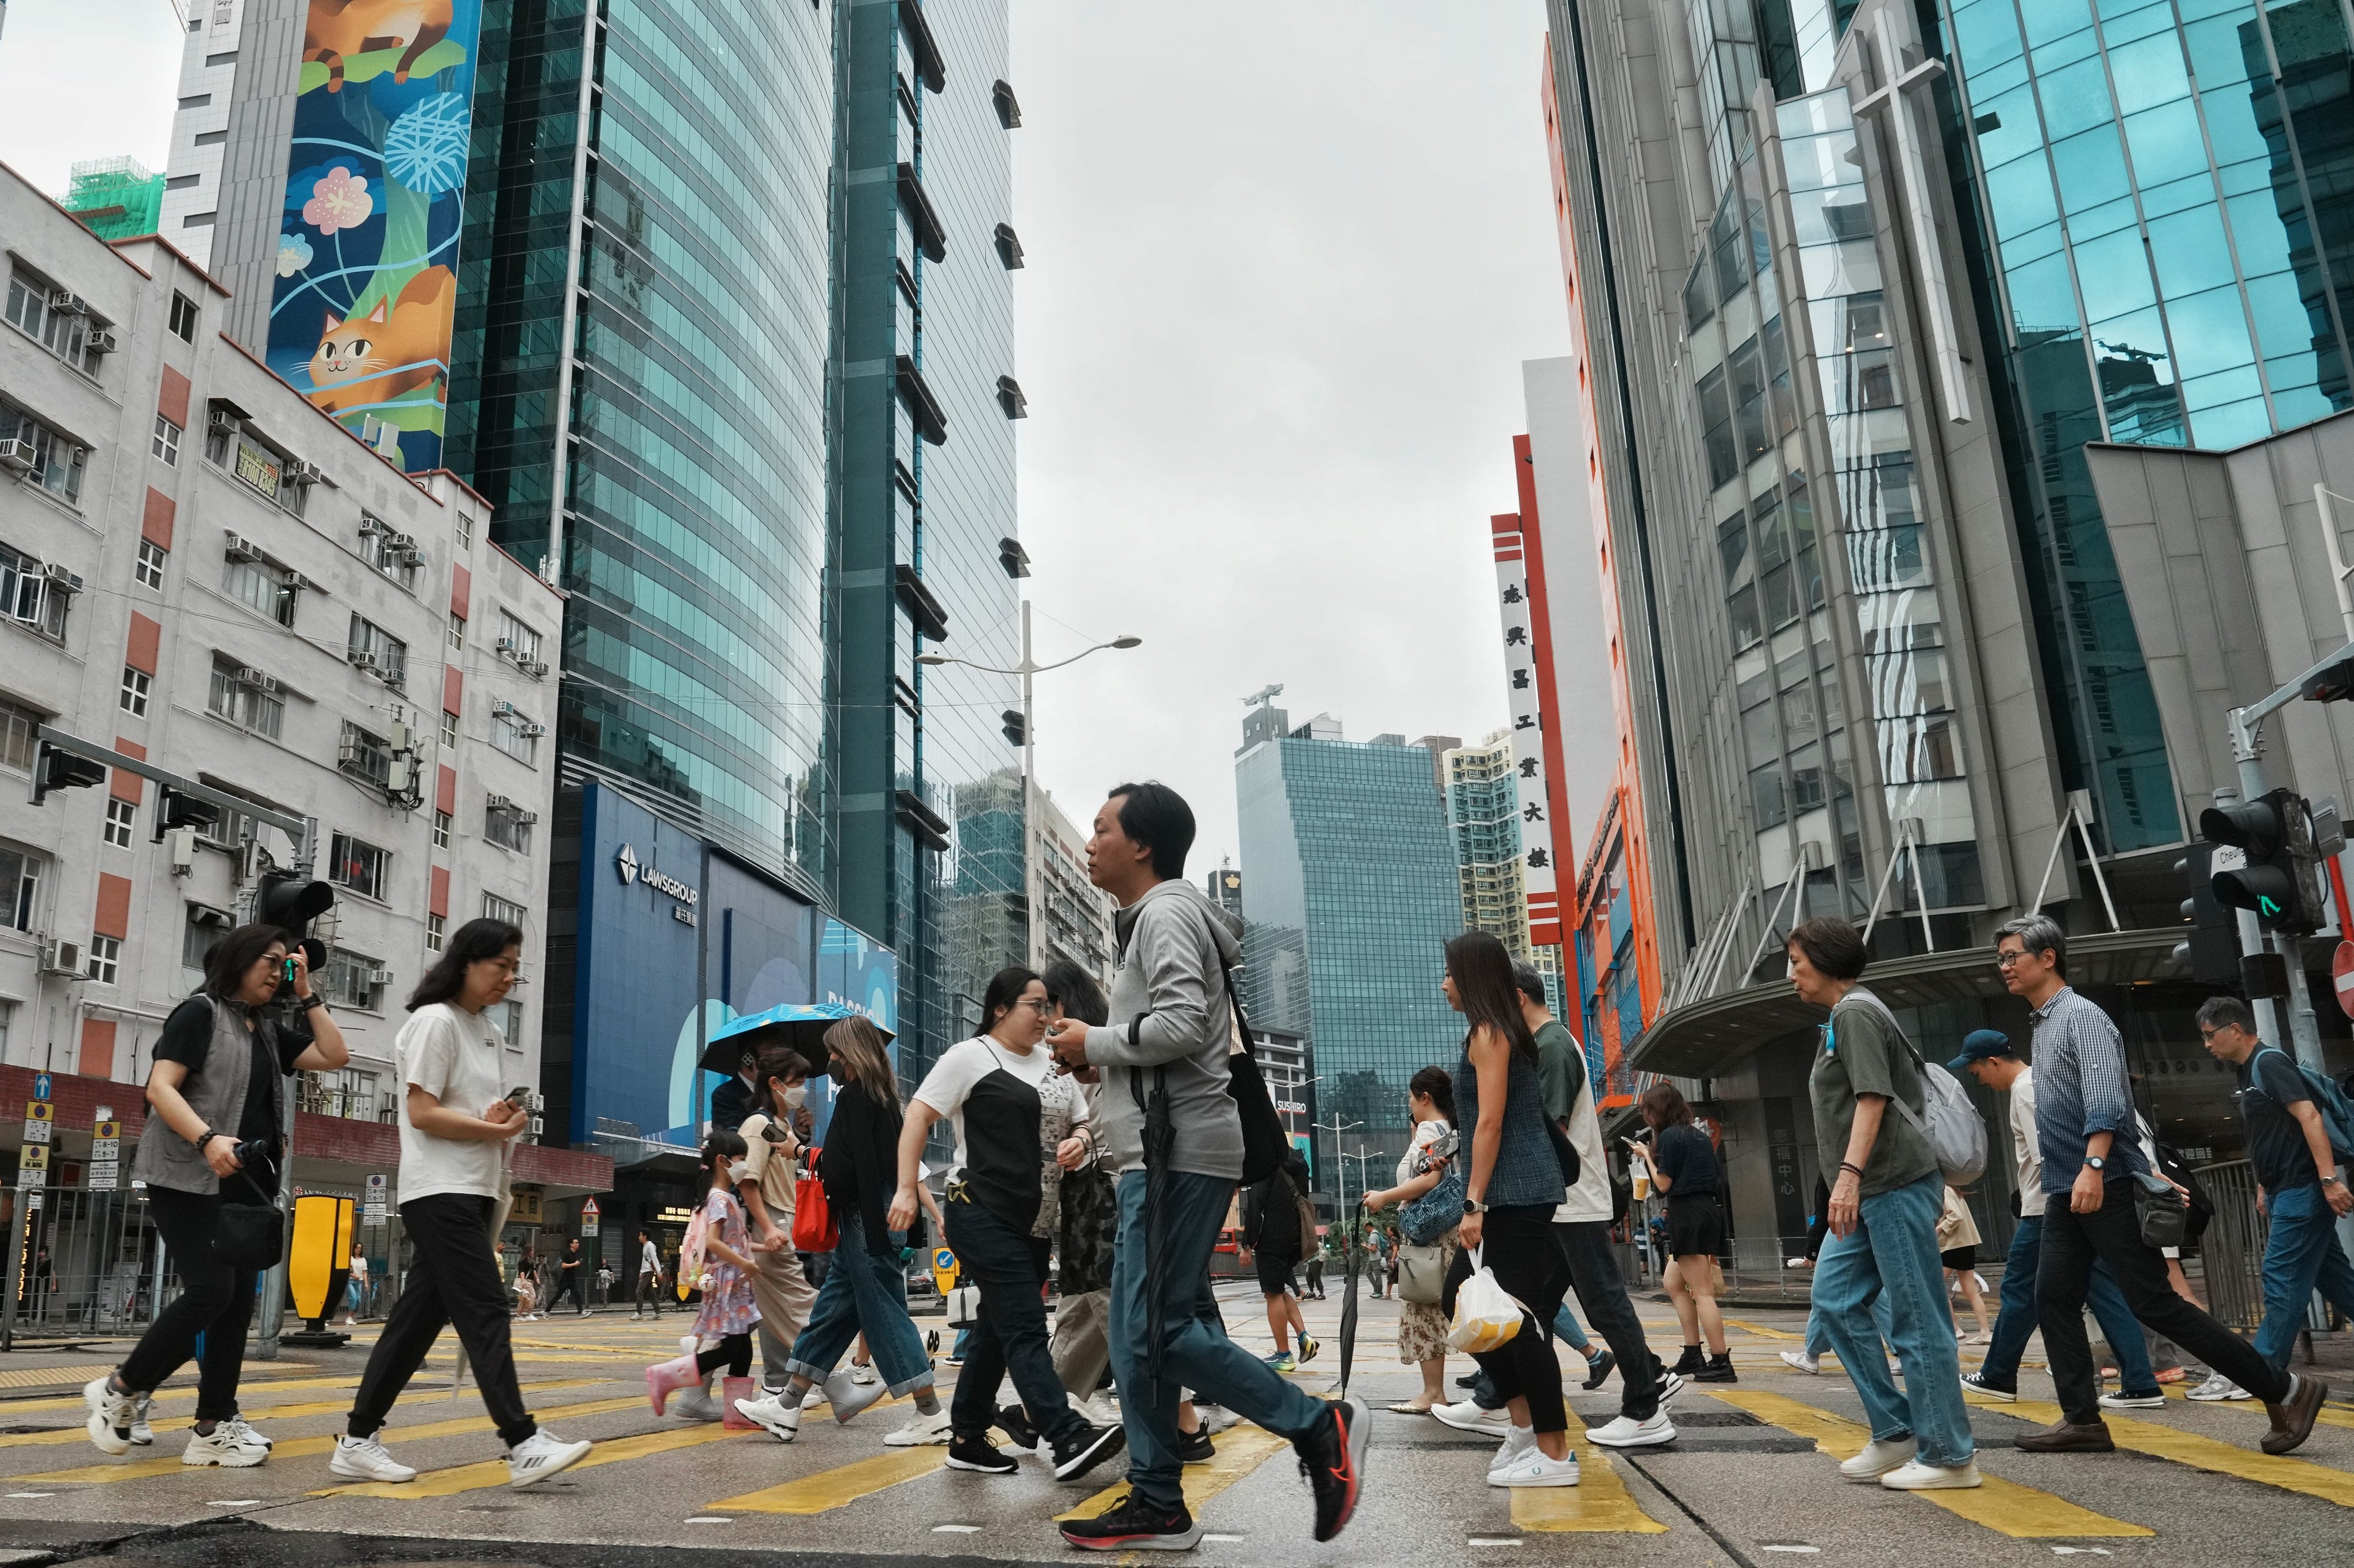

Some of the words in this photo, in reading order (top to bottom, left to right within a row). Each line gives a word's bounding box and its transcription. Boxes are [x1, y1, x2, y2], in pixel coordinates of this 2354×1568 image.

[641, 864, 698, 906] LAWSGROUP
[1277, 1100, 1306, 1114] SUSHIRO
[1774, 1129, 1794, 1195] 恩福中心
